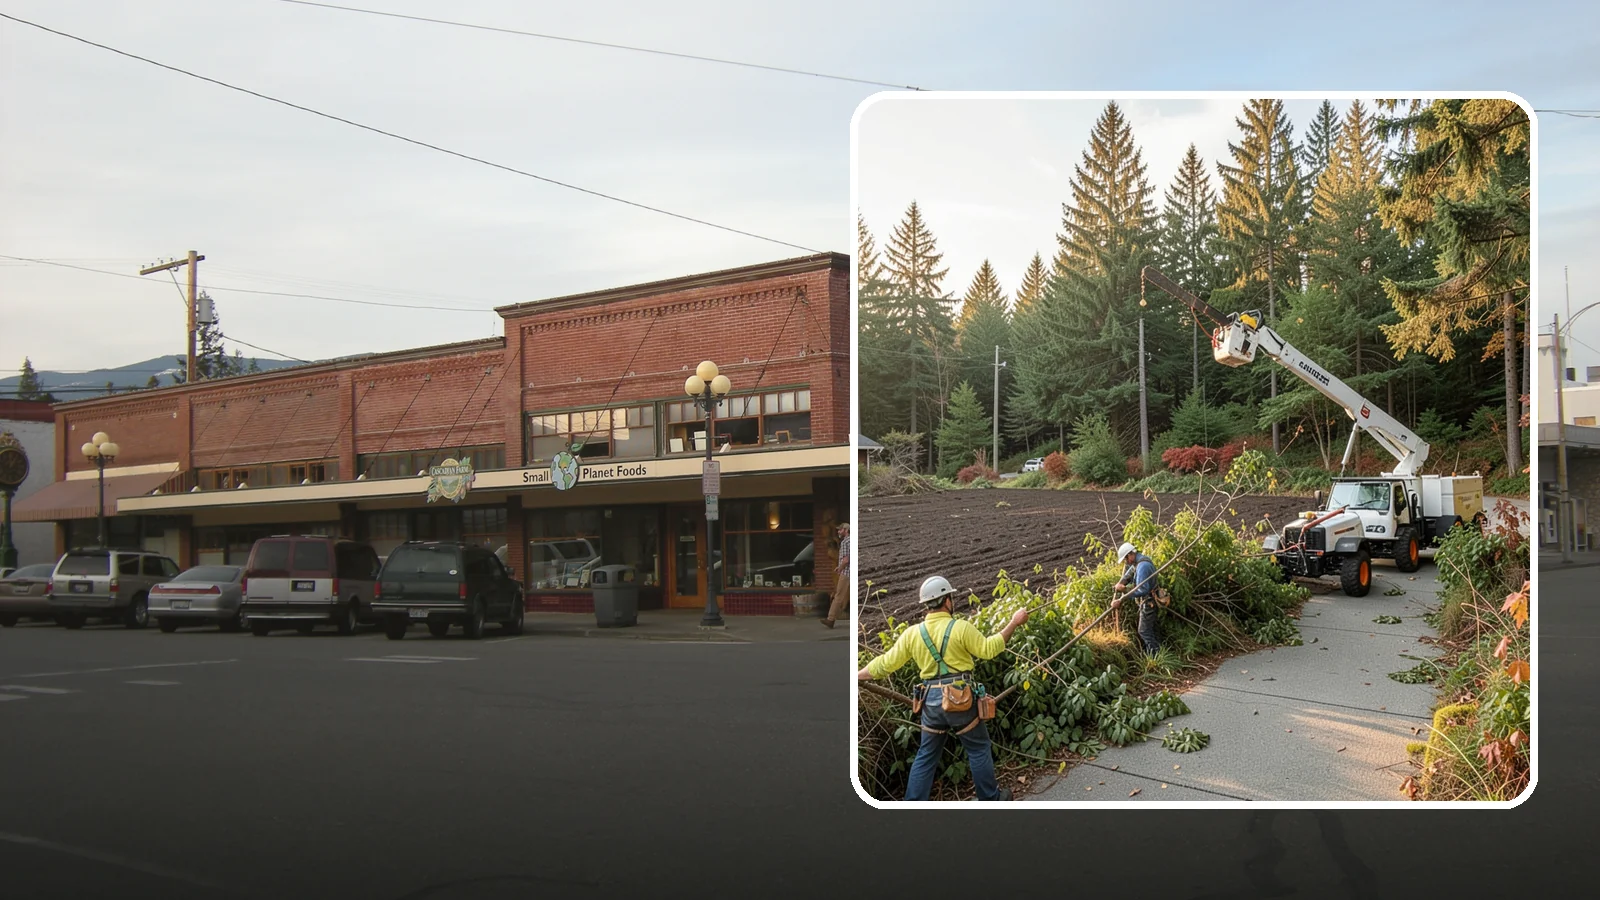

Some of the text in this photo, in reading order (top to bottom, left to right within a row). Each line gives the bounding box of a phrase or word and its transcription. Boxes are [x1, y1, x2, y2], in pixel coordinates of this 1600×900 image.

[523, 464, 647, 483] Small Planet Foods
